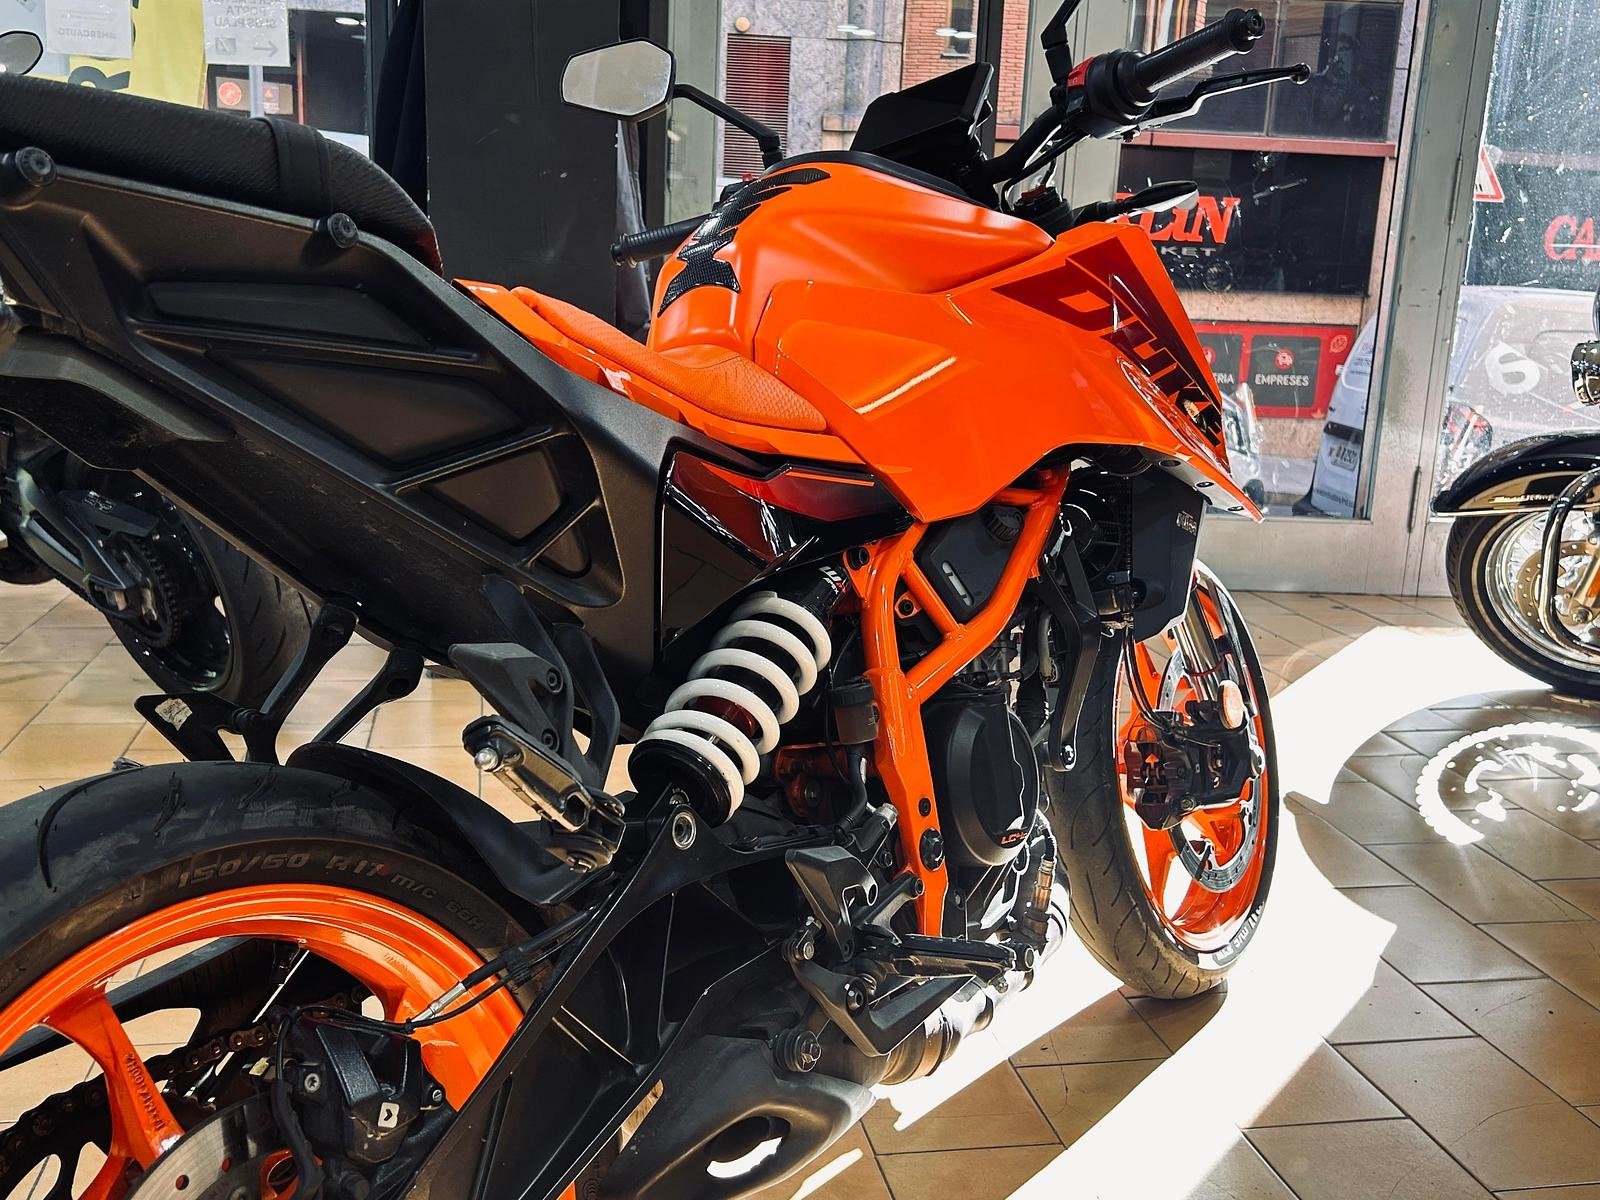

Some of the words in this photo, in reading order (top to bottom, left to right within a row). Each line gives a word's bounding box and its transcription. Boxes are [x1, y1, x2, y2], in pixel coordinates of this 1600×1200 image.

[991, 258, 1221, 447] DUKE
[1485, 341, 1540, 394] 6
[1255, 373, 1310, 386] EMPRESES
[178, 853, 311, 889] 150/60
